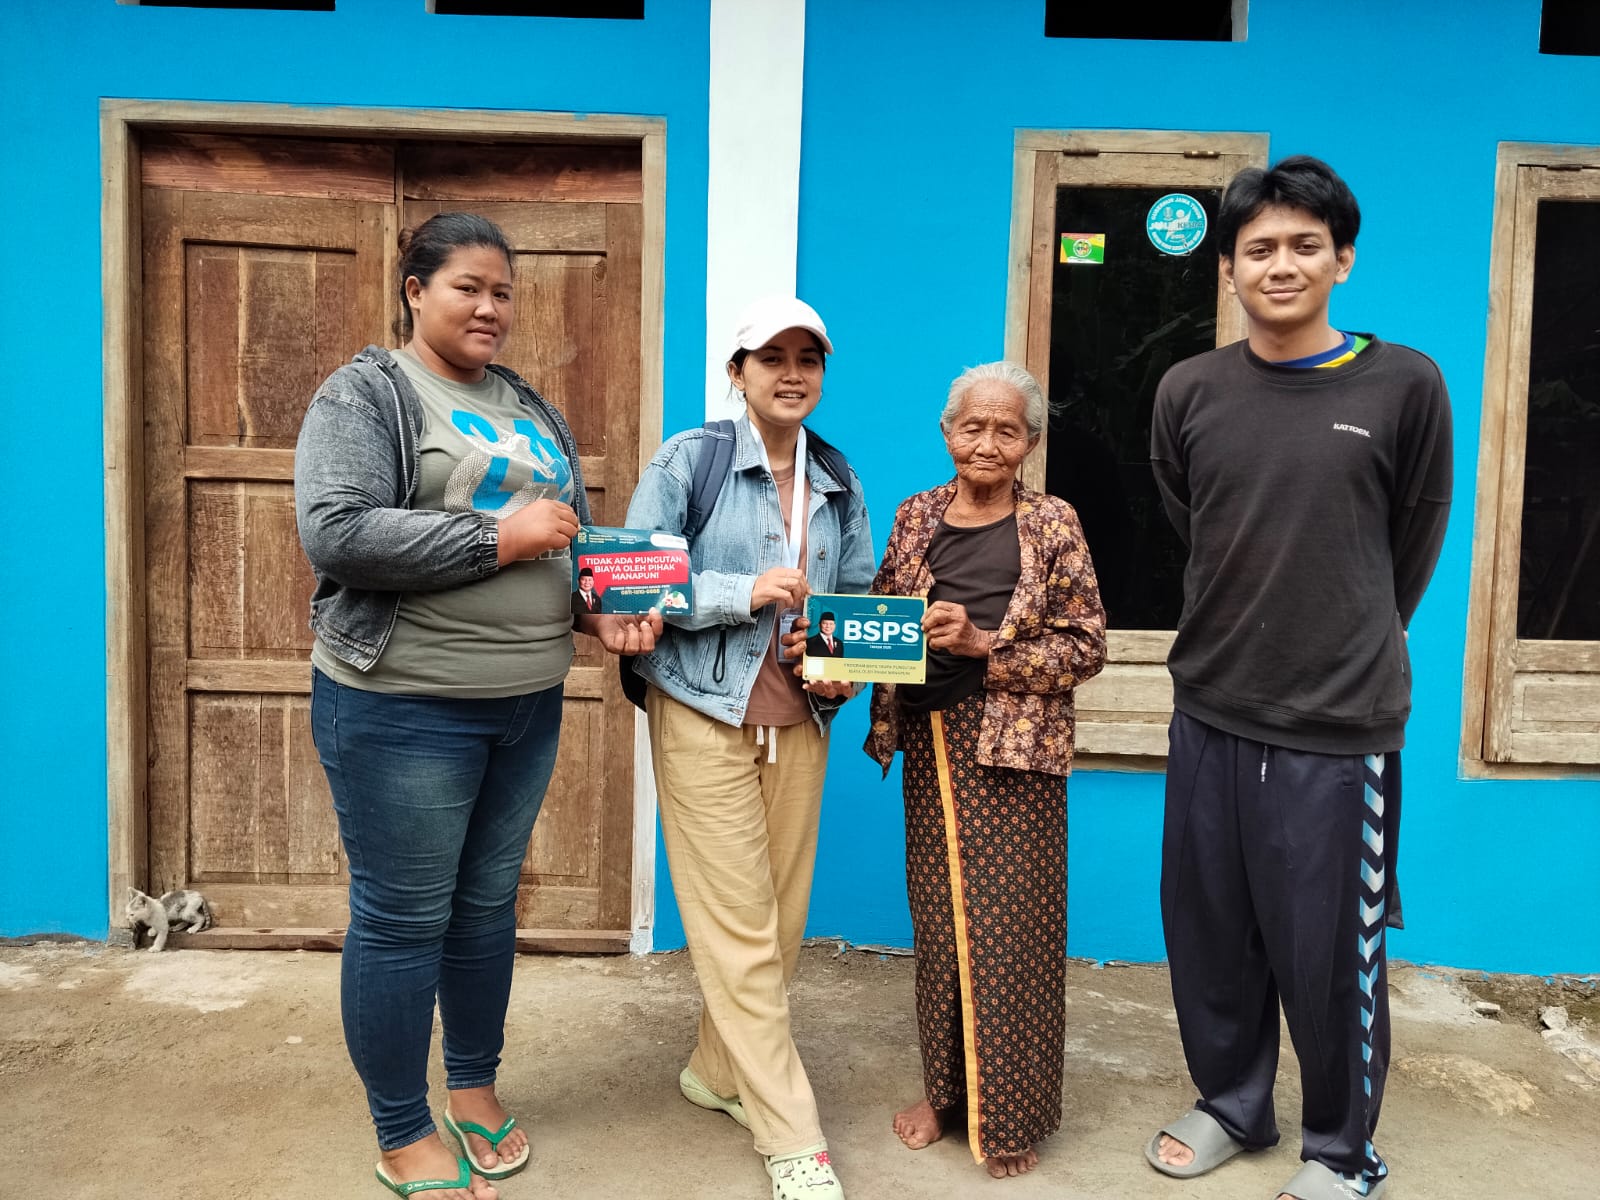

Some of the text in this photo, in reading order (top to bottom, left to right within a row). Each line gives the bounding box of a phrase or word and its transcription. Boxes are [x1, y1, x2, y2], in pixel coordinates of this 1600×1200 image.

[585, 556, 682, 565] TIDAK ADA PUNGUTAN
[594, 563, 676, 573] BIAYA OLEH PIHAK
[612, 572, 660, 580] MANAPUN!
[843, 619, 920, 643] BSPS
